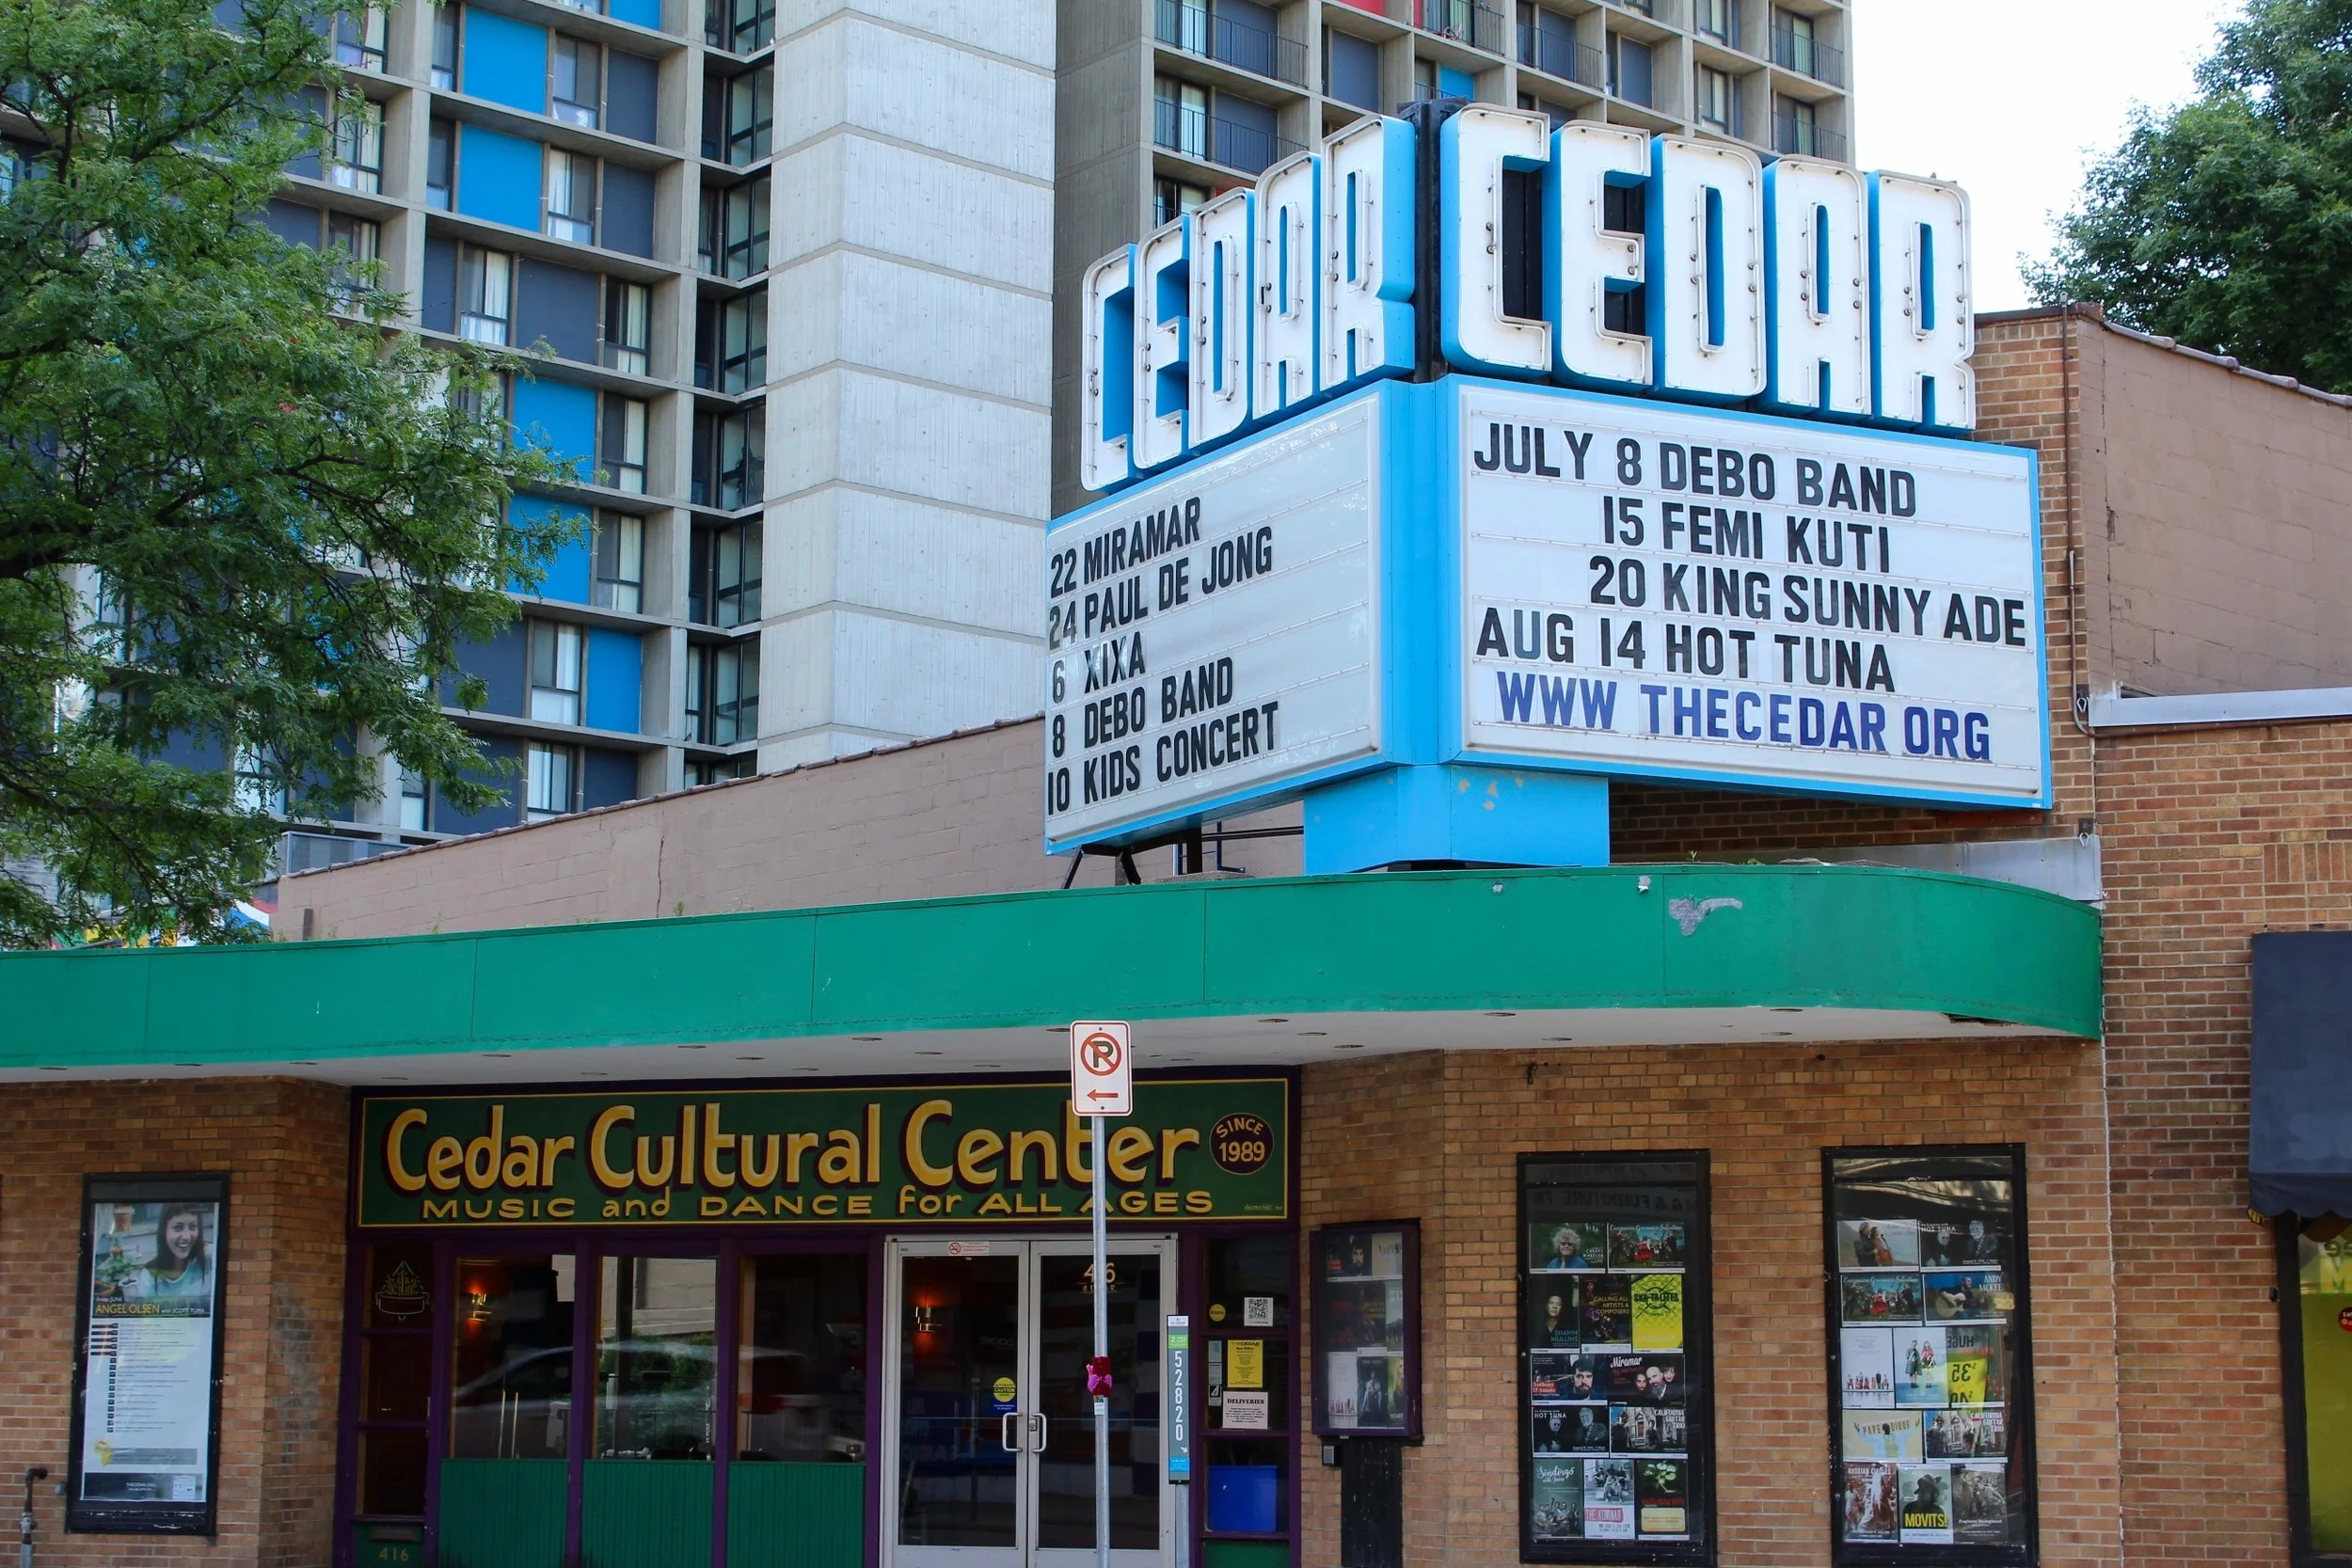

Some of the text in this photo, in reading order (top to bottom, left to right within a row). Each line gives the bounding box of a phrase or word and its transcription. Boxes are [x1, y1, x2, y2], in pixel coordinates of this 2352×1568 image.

[1082, 114, 1415, 491] CEDAR
[1441, 103, 1977, 435] CEDAR
[1474, 423, 1916, 517] JULY 8 DEBO BAND
[1049, 497, 1201, 599] 22 MIRAMAR
[1603, 496, 1890, 573] 15 FEMI KUTI
[1049, 526, 1273, 651] 24 PAUL DE JONG
[1589, 556, 2026, 646] 20 KING SUNNY ADE
[1052, 631, 1147, 704] 6 XIXA
[1477, 607, 1896, 692] AUG 14 HOT TUNA
[1052, 657, 1233, 758] 8 DEBO BAND
[1497, 671, 1991, 761] WWW THECEDAR ORG
[1047, 701, 1279, 816] 10 KIDS CONCERT
[386, 1104, 577, 1192] Cedar
[590, 1102, 882, 1190] Cultural
[1216, 1117, 1265, 1139] SINCE
[1218, 1140, 1266, 1164] 1989
[421, 1198, 576, 1219] MUSIC
[601, 1186, 671, 1218] and
[700, 1194, 872, 1217] DANCE
[898, 1184, 963, 1215] for
[977, 1192, 1062, 1215] ALL
[96, 1304, 127, 1314] ANGEL
[128, 1304, 160, 1314] OLSEN
[1083, 1262, 1116, 1284] 46
[1983, 1275, 2003, 1283] ANDY
[1174, 1350, 1184, 1442] 52820
[1610, 1356, 1643, 1369] Miramar
[1654, 1408, 1685, 1417] CALIFORNIA
[1862, 1424, 1882, 1436] PAPE
[377, 1546, 410, 1562] 416
[1904, 1513, 1948, 1528] MOVITS!
